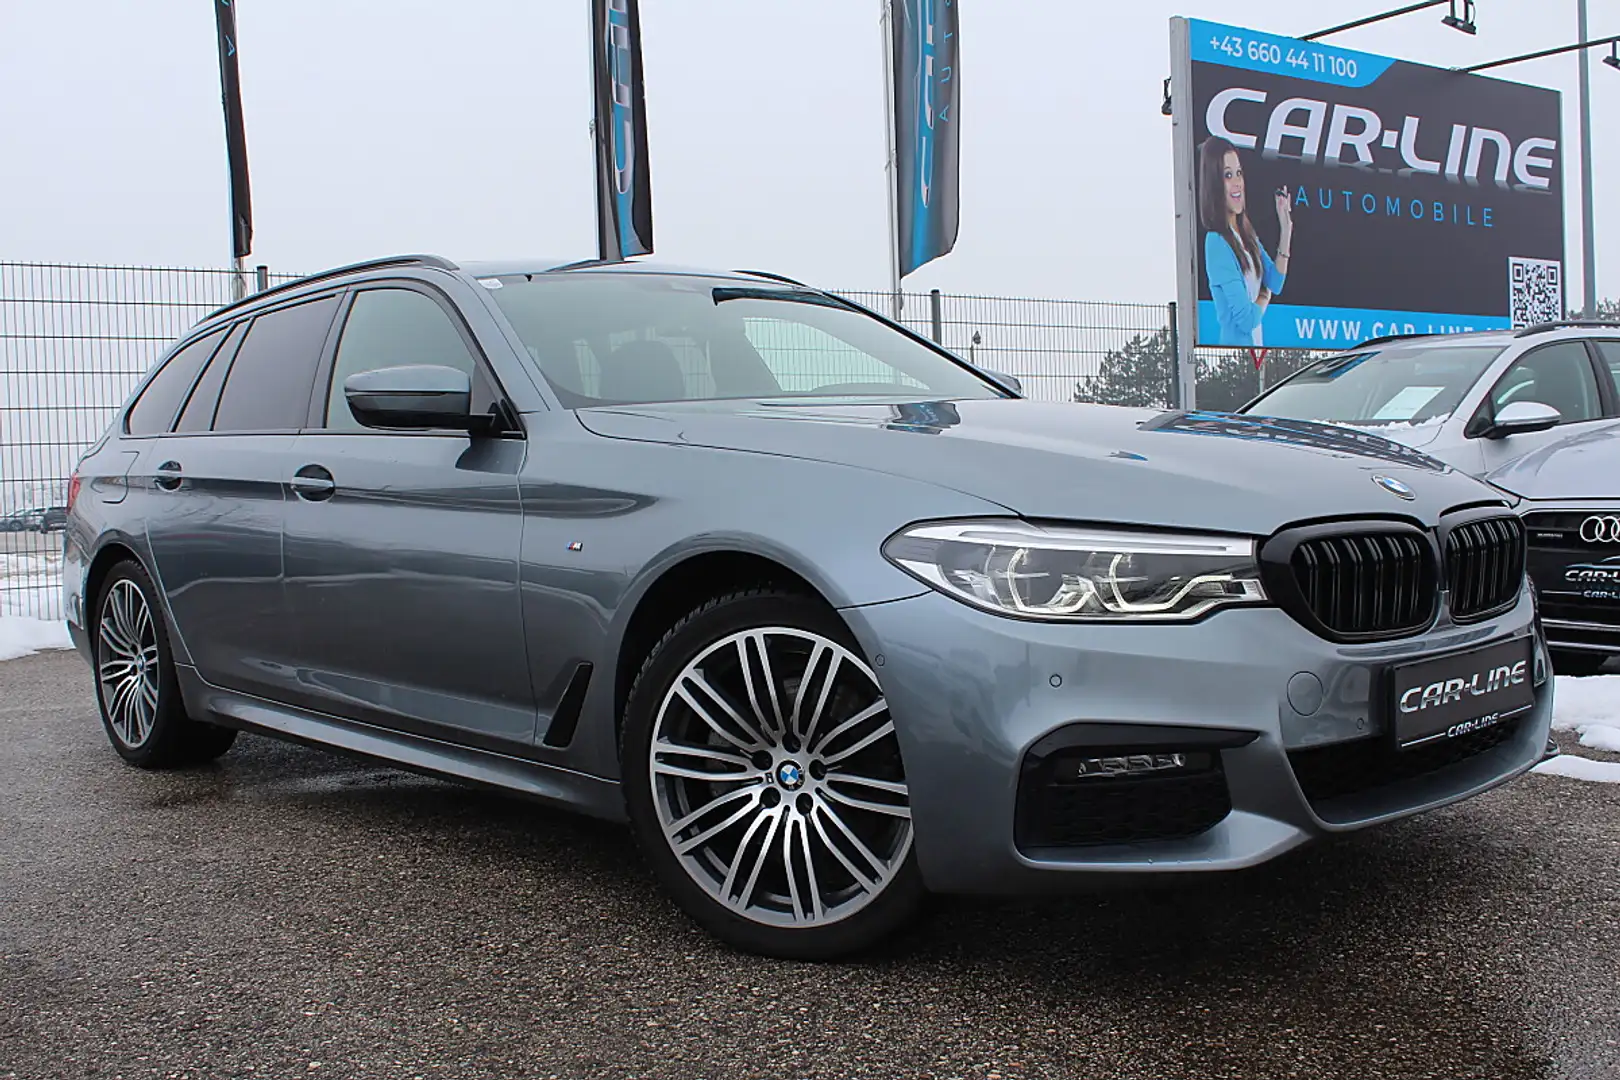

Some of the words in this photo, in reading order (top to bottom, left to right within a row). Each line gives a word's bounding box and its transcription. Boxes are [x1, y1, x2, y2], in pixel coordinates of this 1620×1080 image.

[1209, 36, 1243, 57] +43
[1248, 40, 1281, 65] 660
[1285, 48, 1310, 70] 44
[1312, 52, 1326, 73] 11
[1329, 55, 1358, 78] 100
[1295, 185, 1495, 228] AUTOMOBILE
